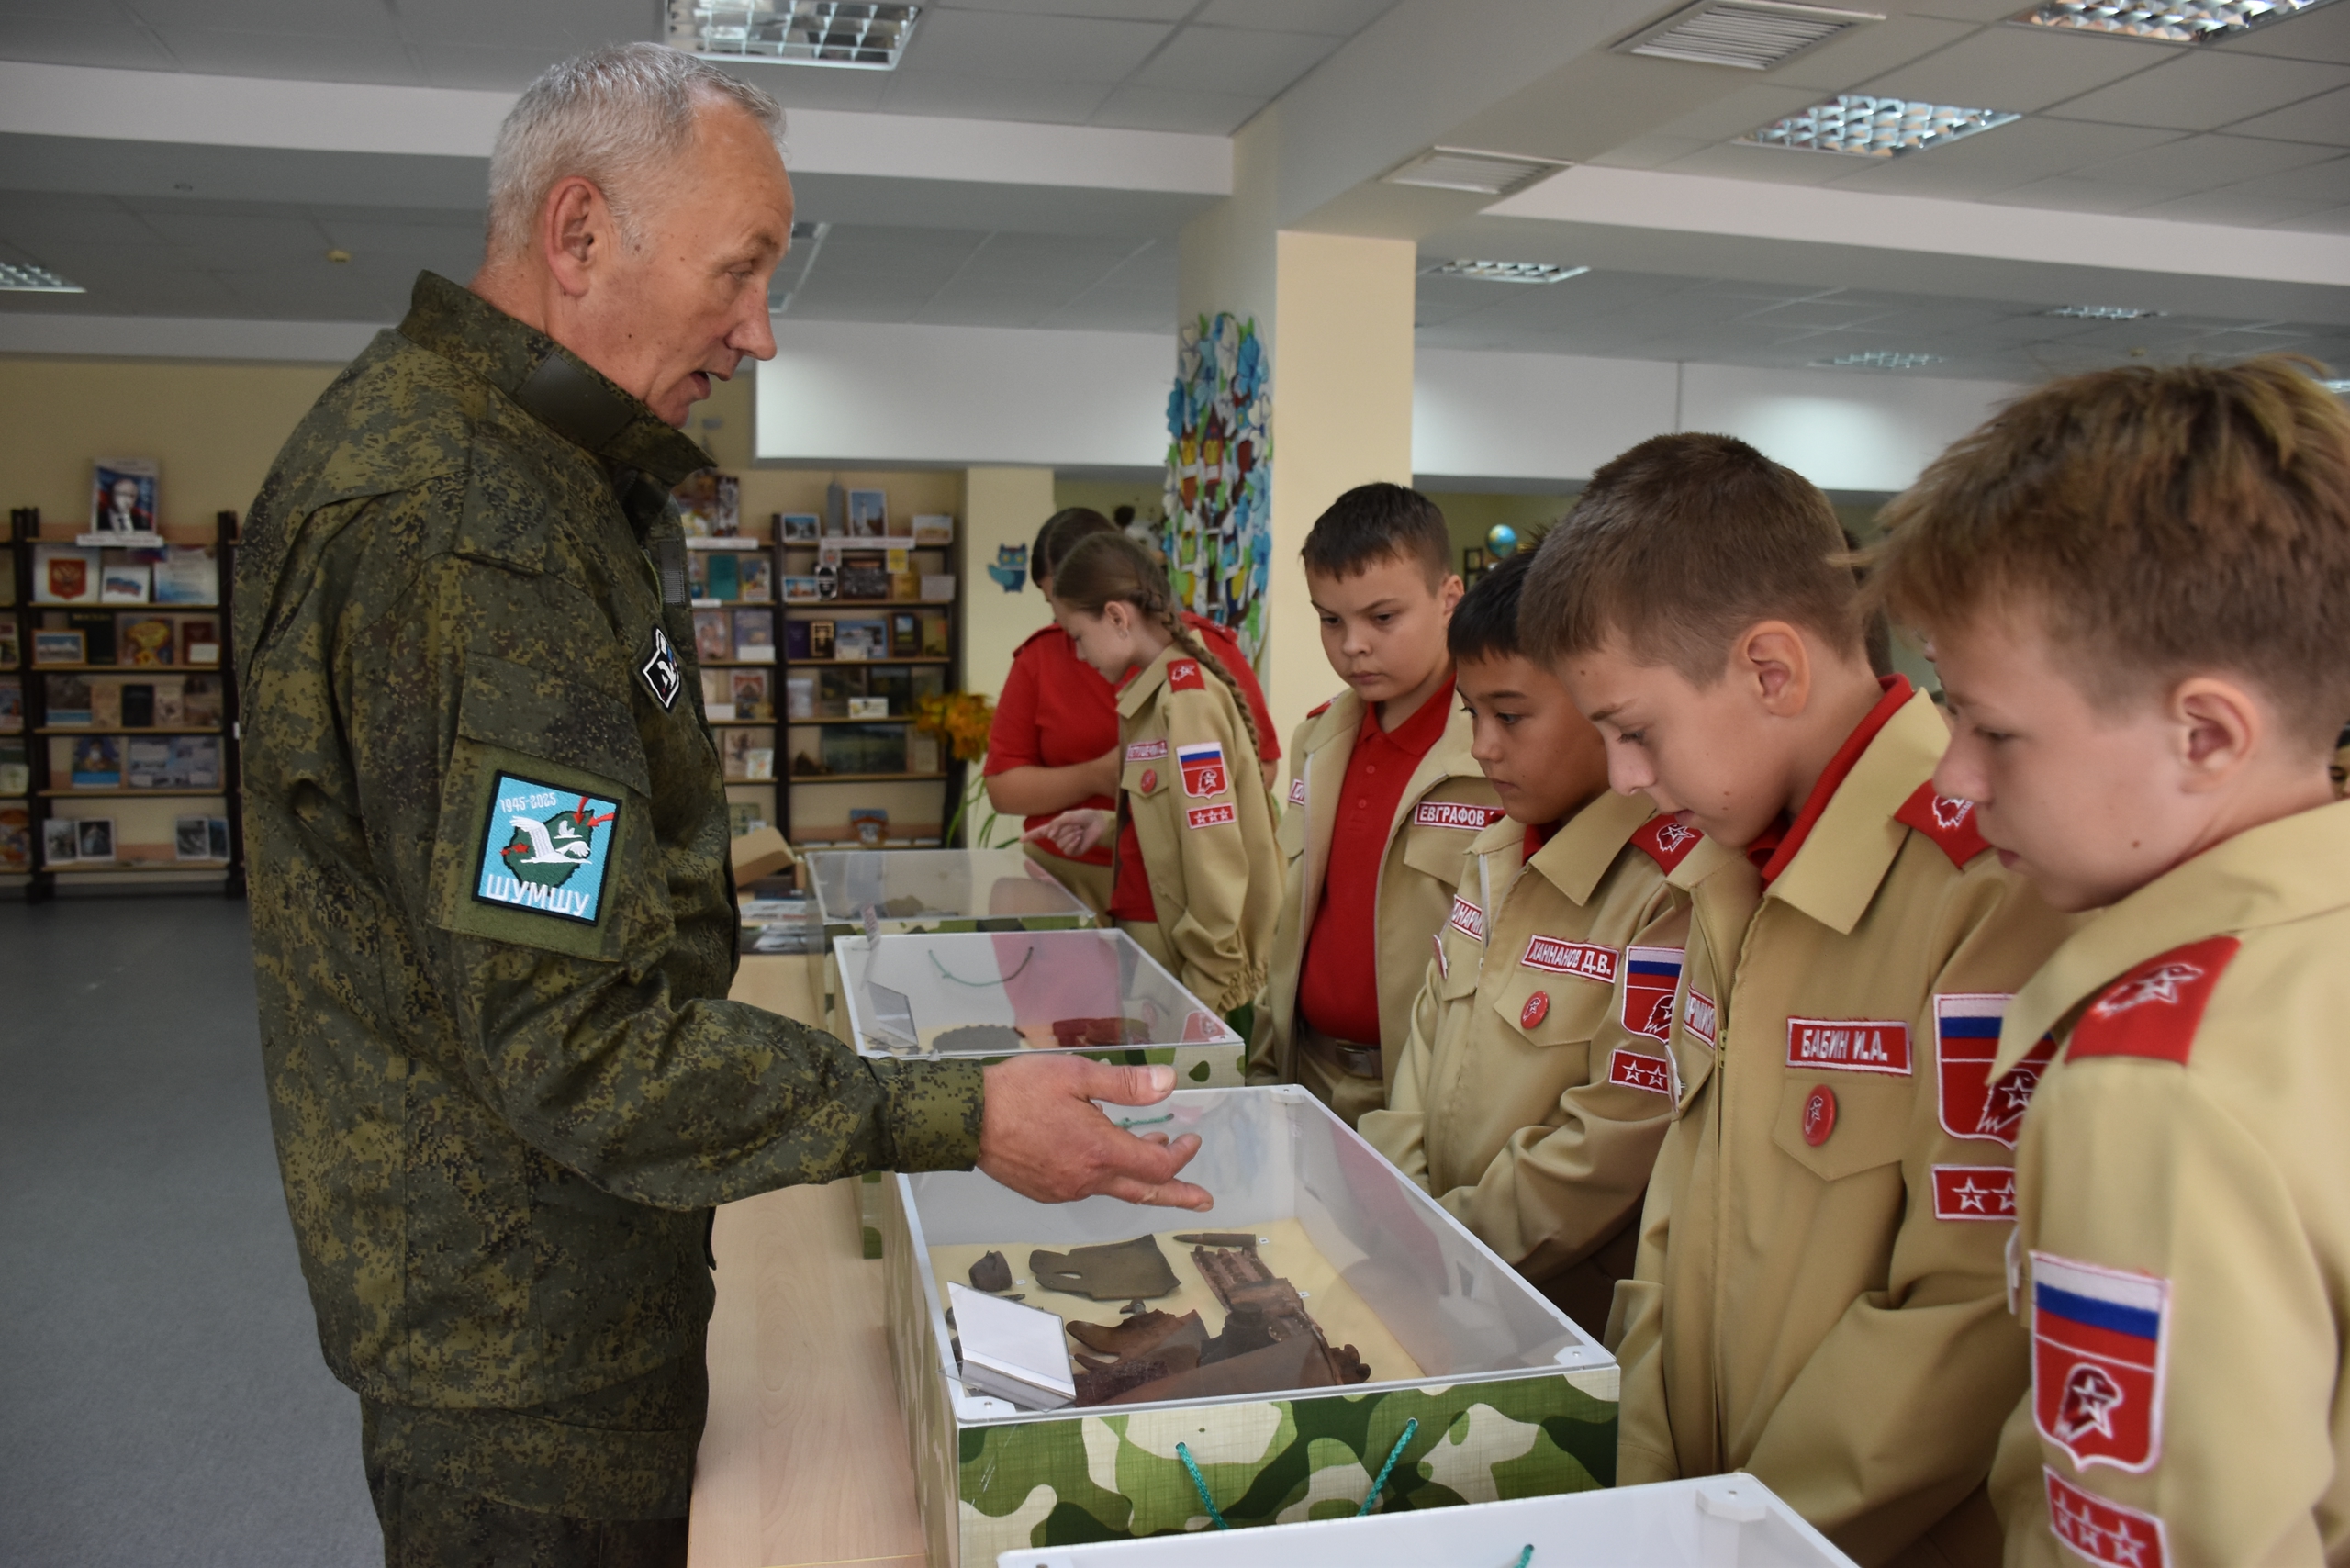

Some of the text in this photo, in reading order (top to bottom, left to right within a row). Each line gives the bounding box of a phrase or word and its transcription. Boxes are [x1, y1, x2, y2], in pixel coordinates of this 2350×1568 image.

[500, 792, 557, 813] 1945-2025
[1419, 806, 1485, 825] ЕВГРАФОВ
[486, 874, 590, 917] ШУМШУ
[1528, 941, 1612, 975] ХАННАНОВ Д.В.
[1801, 1029, 1888, 1062] БАБИН И.А.
